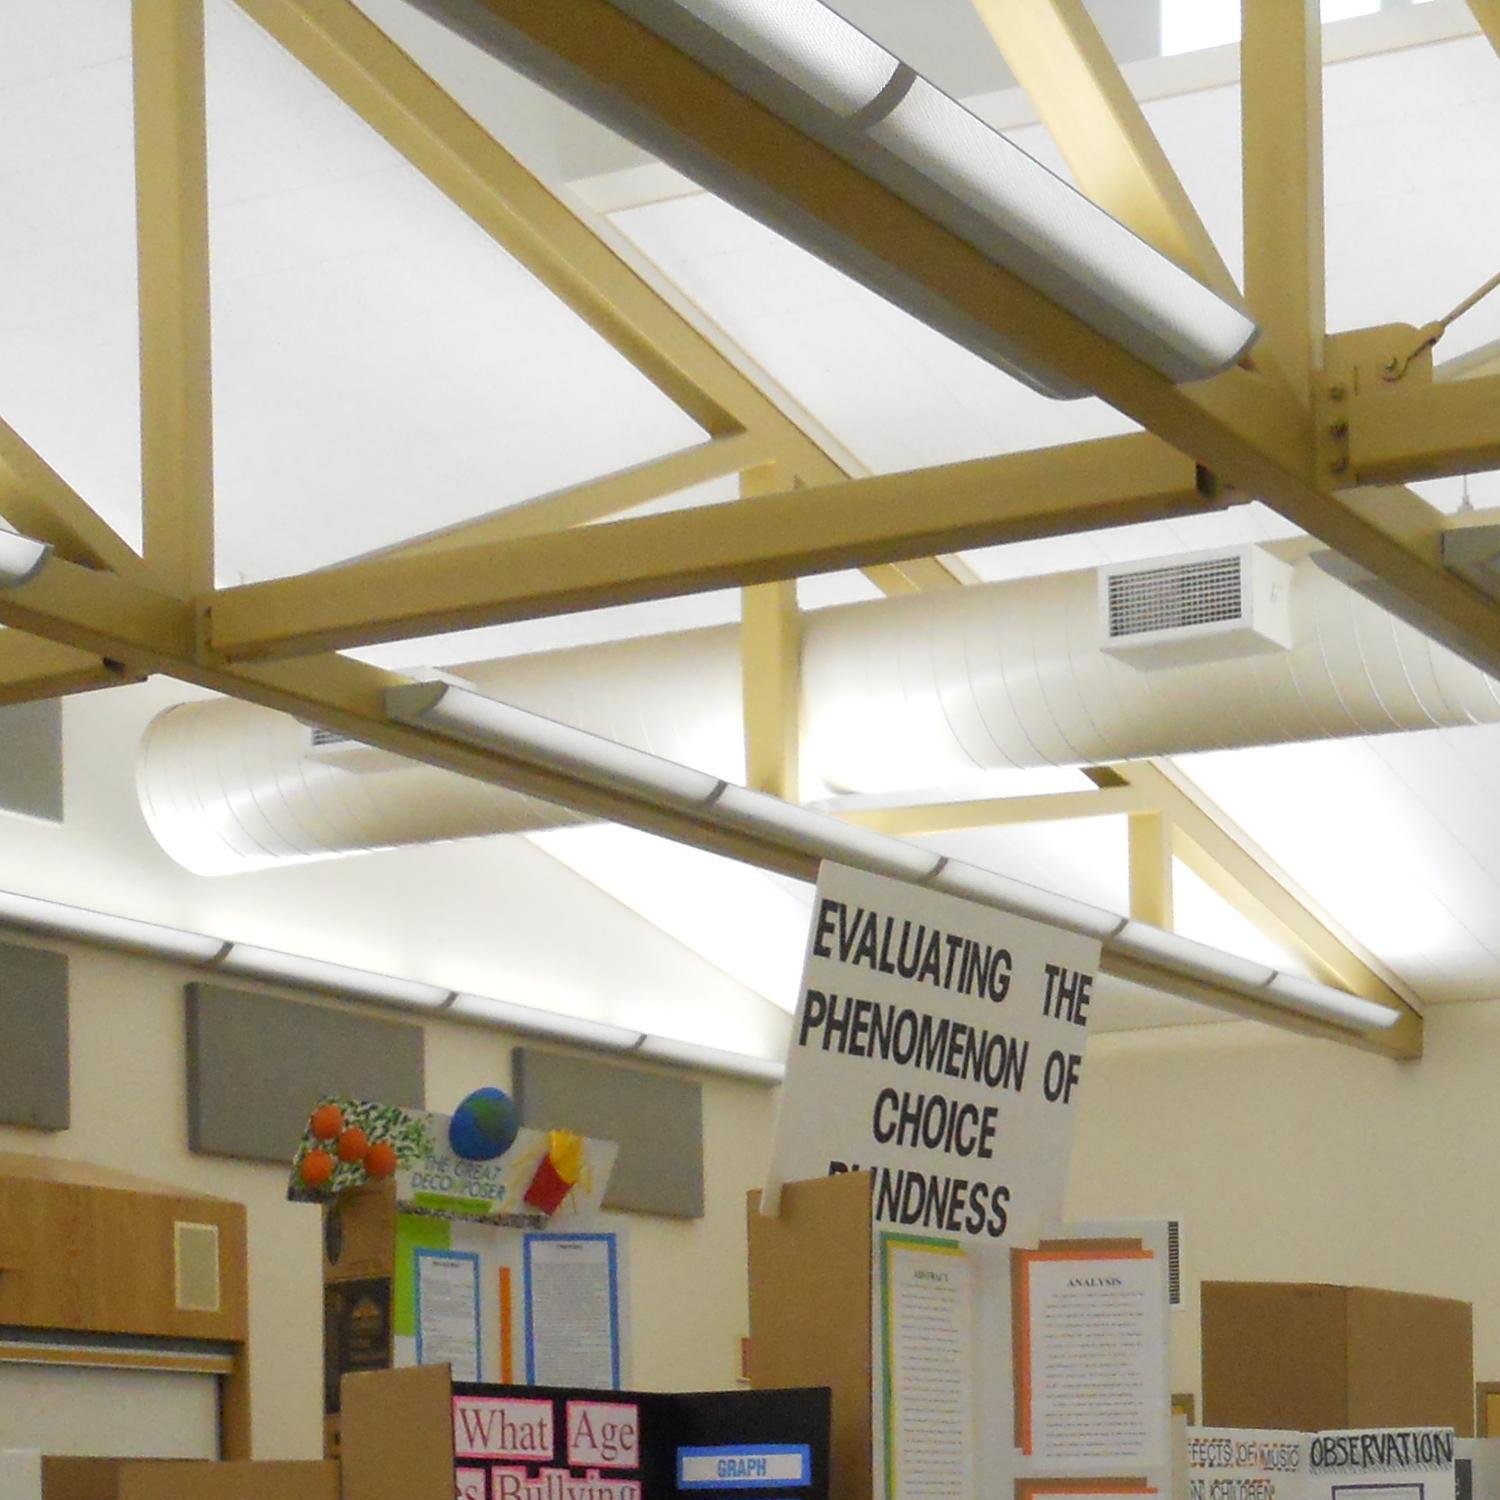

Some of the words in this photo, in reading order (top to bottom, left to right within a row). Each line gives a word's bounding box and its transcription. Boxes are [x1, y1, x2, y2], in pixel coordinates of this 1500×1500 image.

[813, 899, 1012, 1003] EVALUATING
[1042, 963, 1092, 1026] THE
[799, 989, 1029, 1092] PHENOMENON
[1043, 1050, 1081, 1104] OF
[872, 1088, 998, 1158] CHOICE
[829, 1161, 1010, 1237] NDNESS
[1066, 1277, 1123, 1288] ANALYSIS
[460, 1408, 548, 1451] What
[572, 1410, 635, 1461] Age
[1311, 1432, 1453, 1468] OBSERVATION
[717, 1458, 767, 1478] GRAPH
